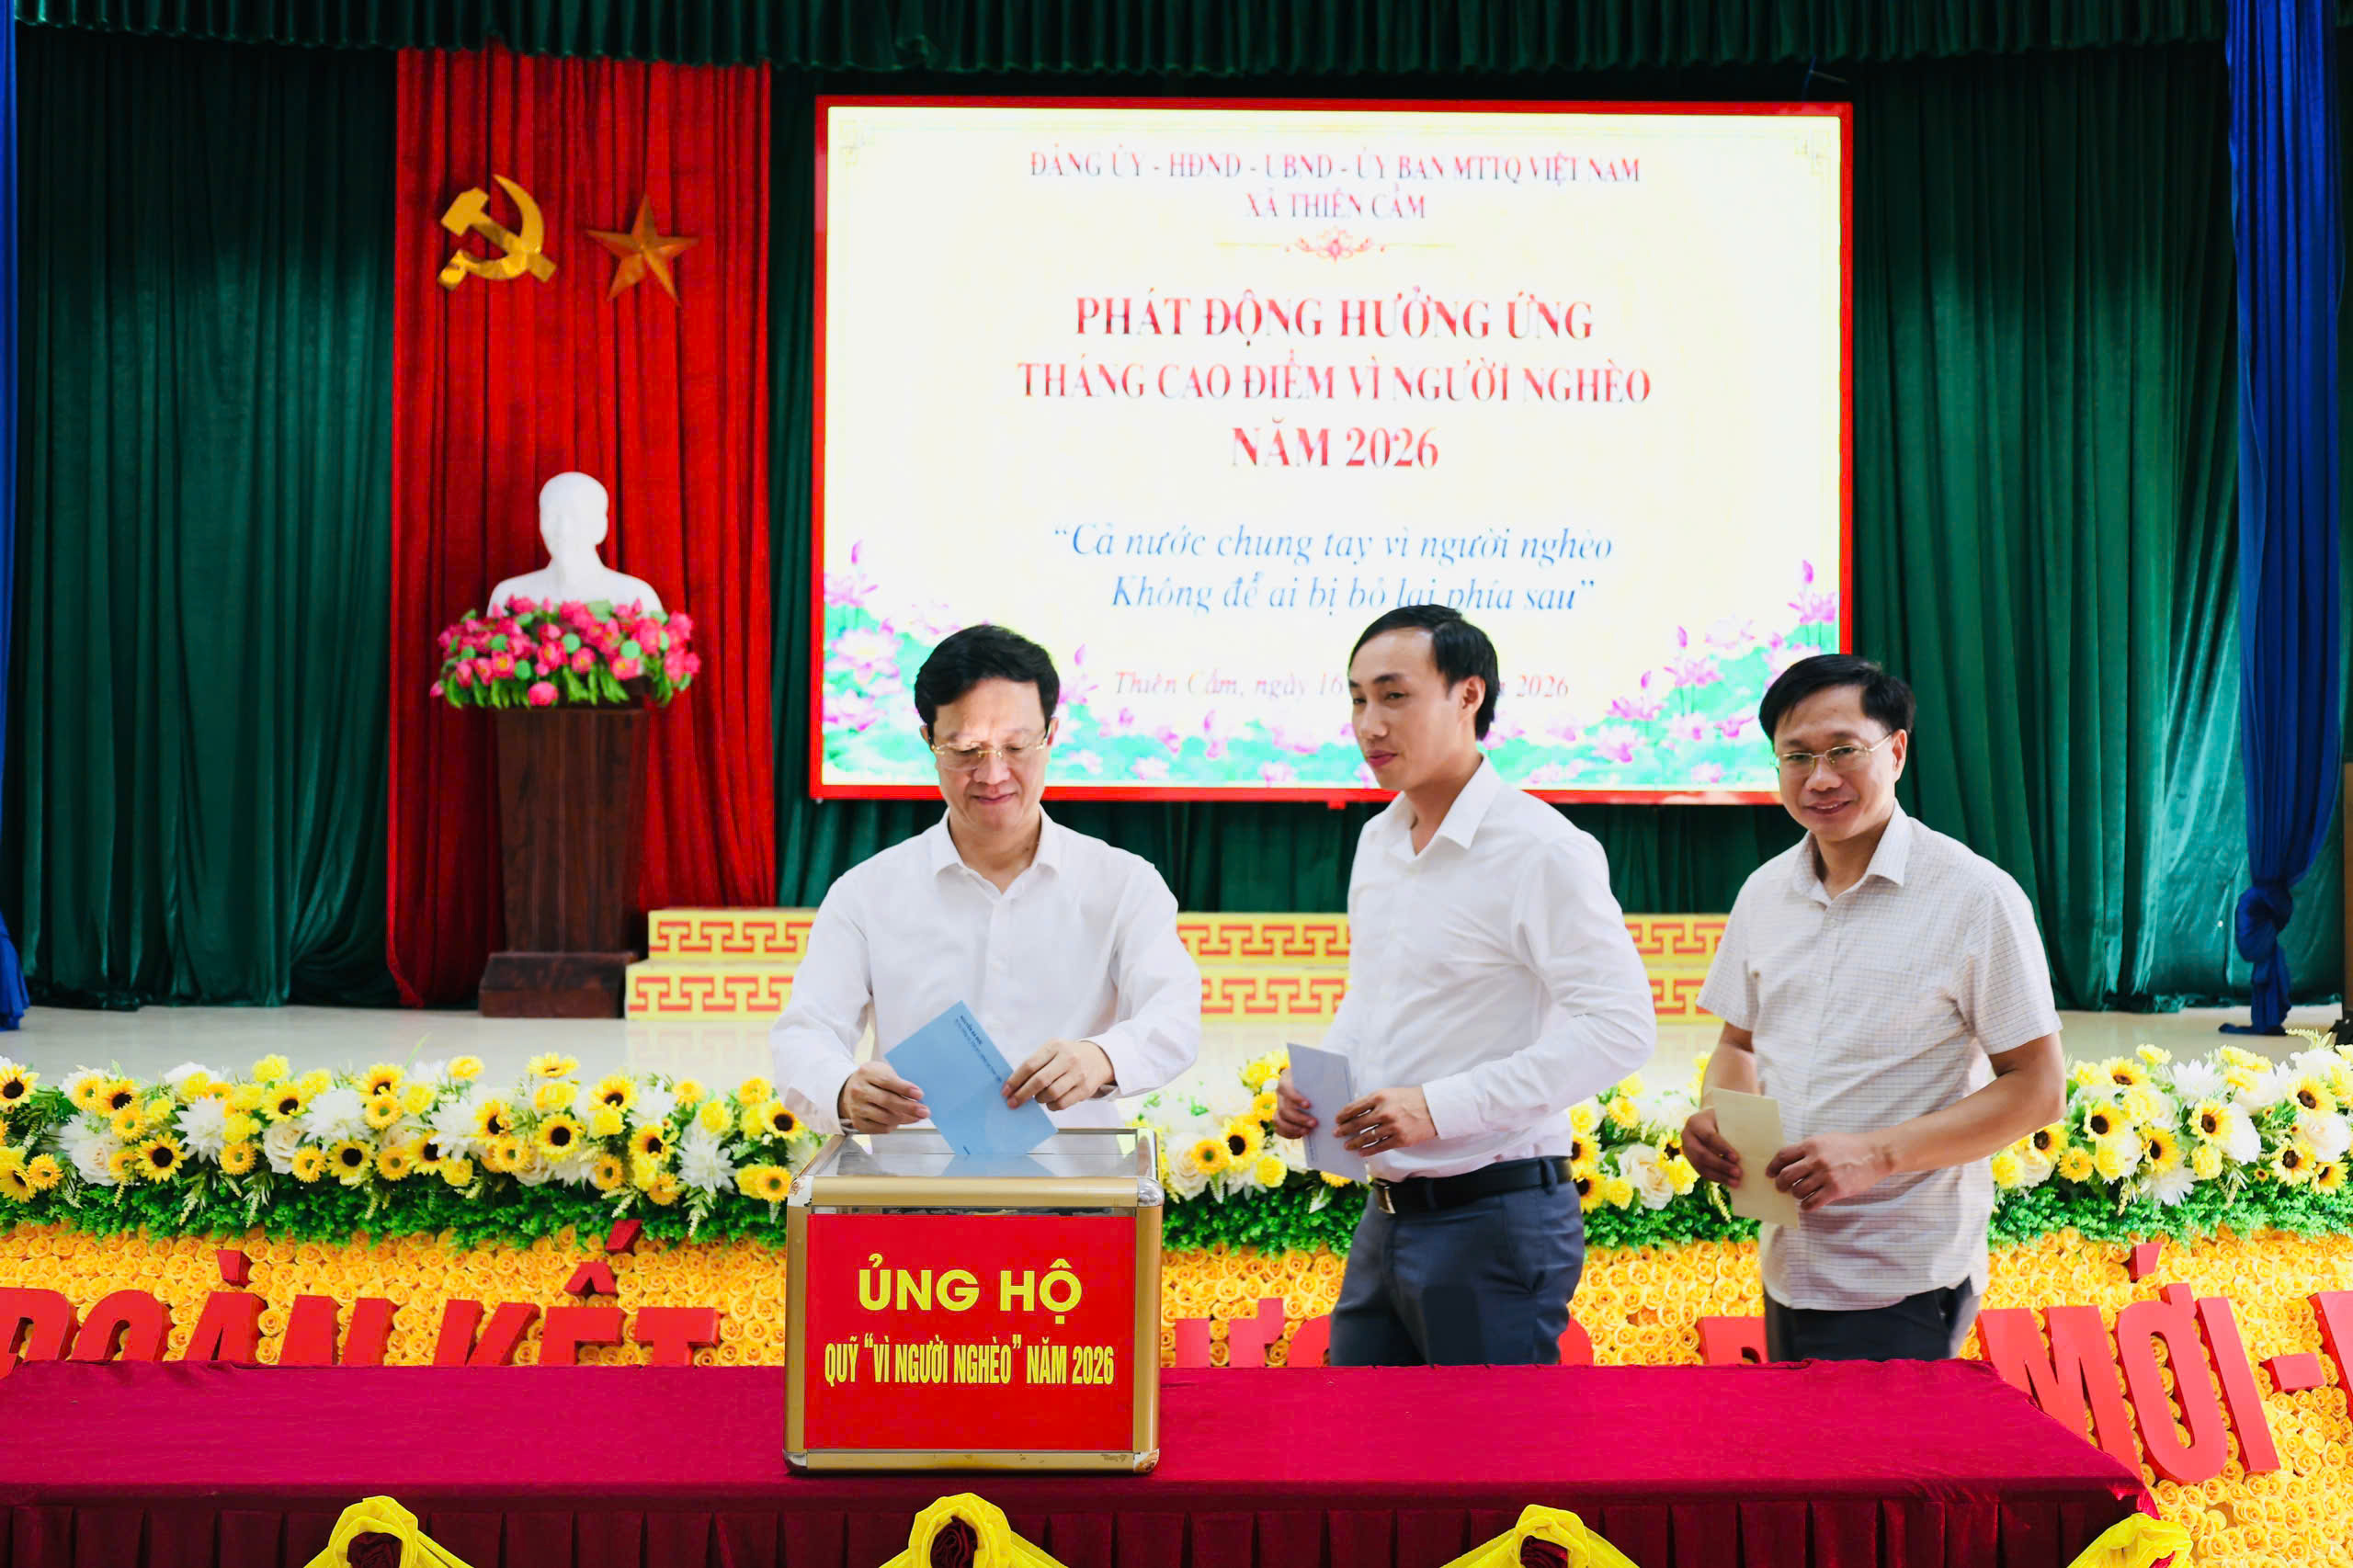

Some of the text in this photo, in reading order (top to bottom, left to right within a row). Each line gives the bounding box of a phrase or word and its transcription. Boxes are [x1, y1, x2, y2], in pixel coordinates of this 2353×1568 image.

[1030, 142, 1102, 177] ĐẢNG
[1110, 143, 1144, 177] ỦY
[1169, 153, 1241, 178] HĐND
[1265, 153, 1333, 178] UBND
[1356, 146, 1387, 179] ỦY
[1398, 154, 1444, 180] BAN
[1454, 155, 1522, 184] MTTQ
[1529, 151, 1580, 186] VIỆT
[1587, 157, 1640, 182] NAM
[1289, 187, 1361, 219] THIÊN
[1075, 285, 1593, 347] PHÁT ĐỘNG HƯỞNG ỨNG
[1017, 348, 1652, 403] THÁNG CAO ĐIỂM VÌ NGƯỜI NGHÈO
[1232, 416, 1439, 468] NĂM 2026
[1125, 524, 1207, 556] nước
[1217, 524, 1314, 565] chung
[1324, 531, 1374, 566] tay
[1384, 526, 1409, 558] vì
[1420, 527, 1512, 567] người
[1520, 526, 1614, 567] nghèo
[1112, 576, 1212, 614] Không
[1222, 570, 1264, 608] để
[1268, 576, 1300, 608] ai
[1308, 576, 1338, 617] bị
[1347, 576, 1387, 609] bỏ
[1446, 577, 1515, 612] phía
[1115, 670, 1177, 695] Thiên
[1256, 671, 1305, 699] ngày
[1515, 674, 1570, 699] 2026
[858, 1253, 1083, 1325] ỦNG HỘ
[824, 1335, 859, 1388] QUỸ
[894, 1335, 949, 1384] NGƯỜI
[1026, 1337, 1067, 1384] NĂM
[1072, 1345, 1115, 1385] 2026
